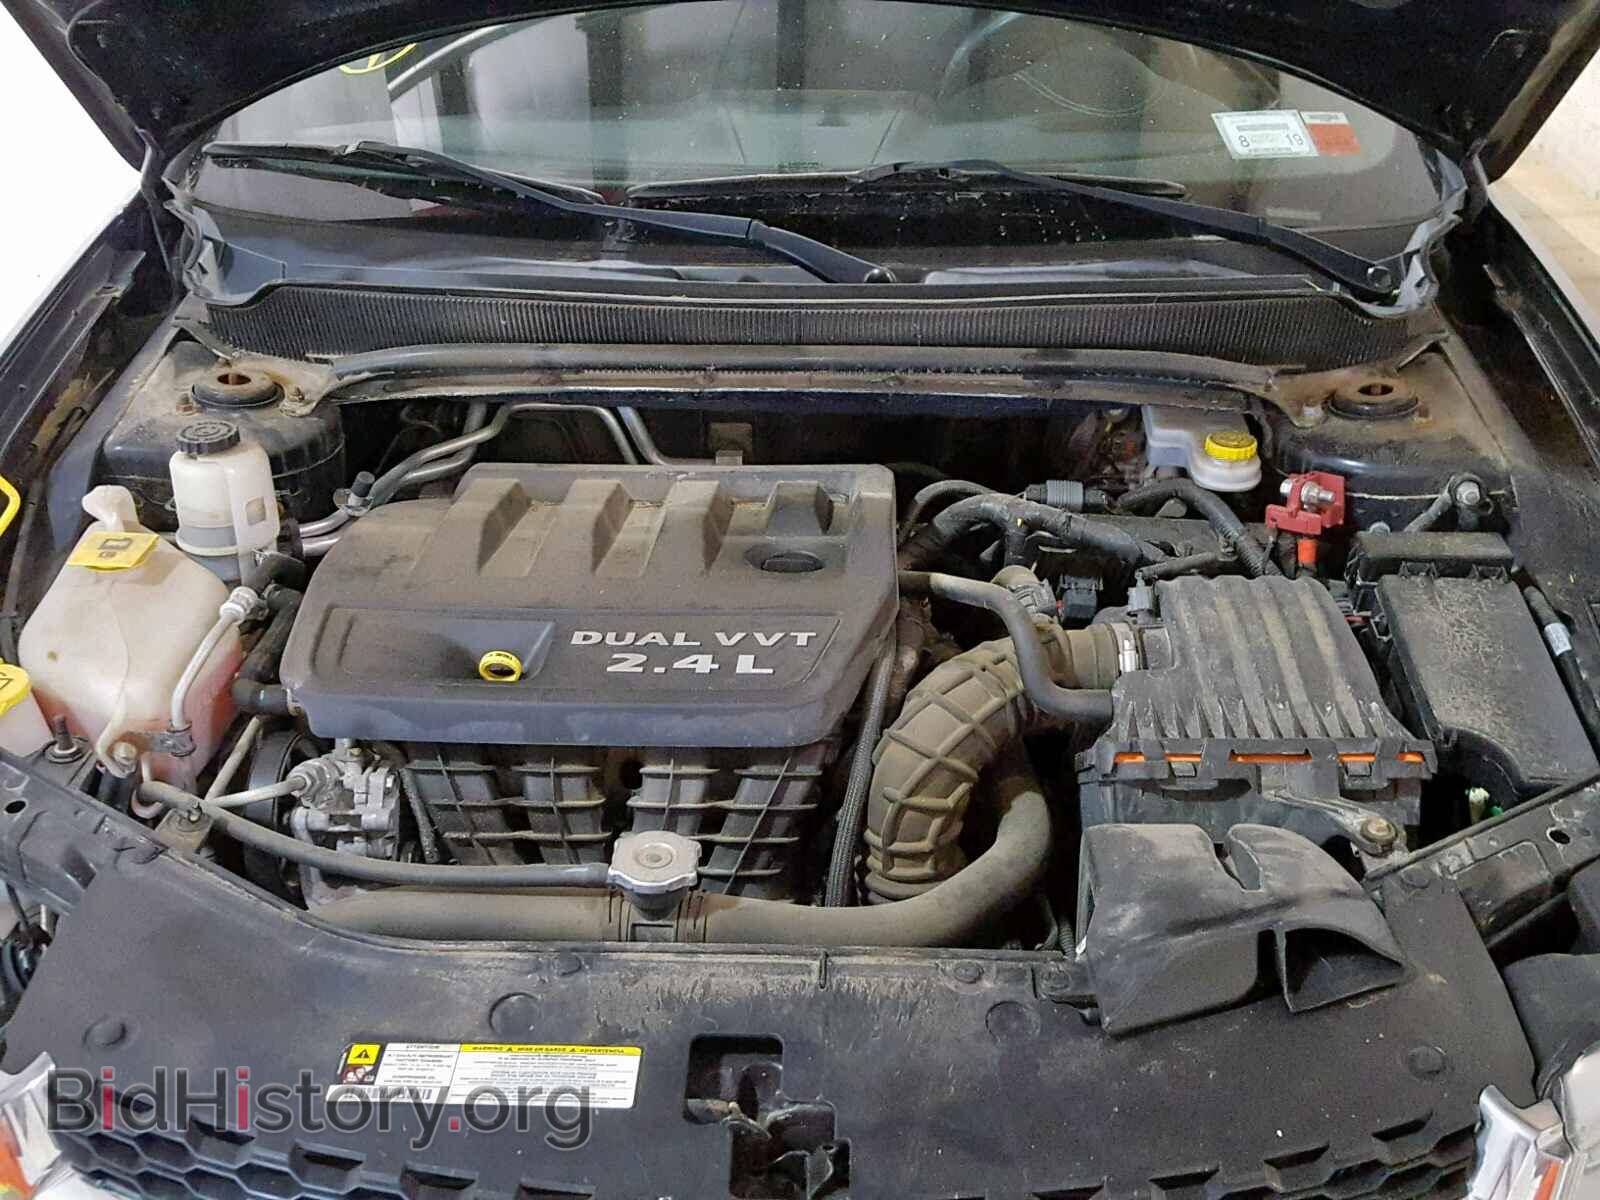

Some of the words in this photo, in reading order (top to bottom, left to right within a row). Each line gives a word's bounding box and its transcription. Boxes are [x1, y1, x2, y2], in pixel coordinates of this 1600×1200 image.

[1238, 135, 1250, 148] 8
[570, 631, 701, 646] DUAL
[714, 631, 817, 647] VVT
